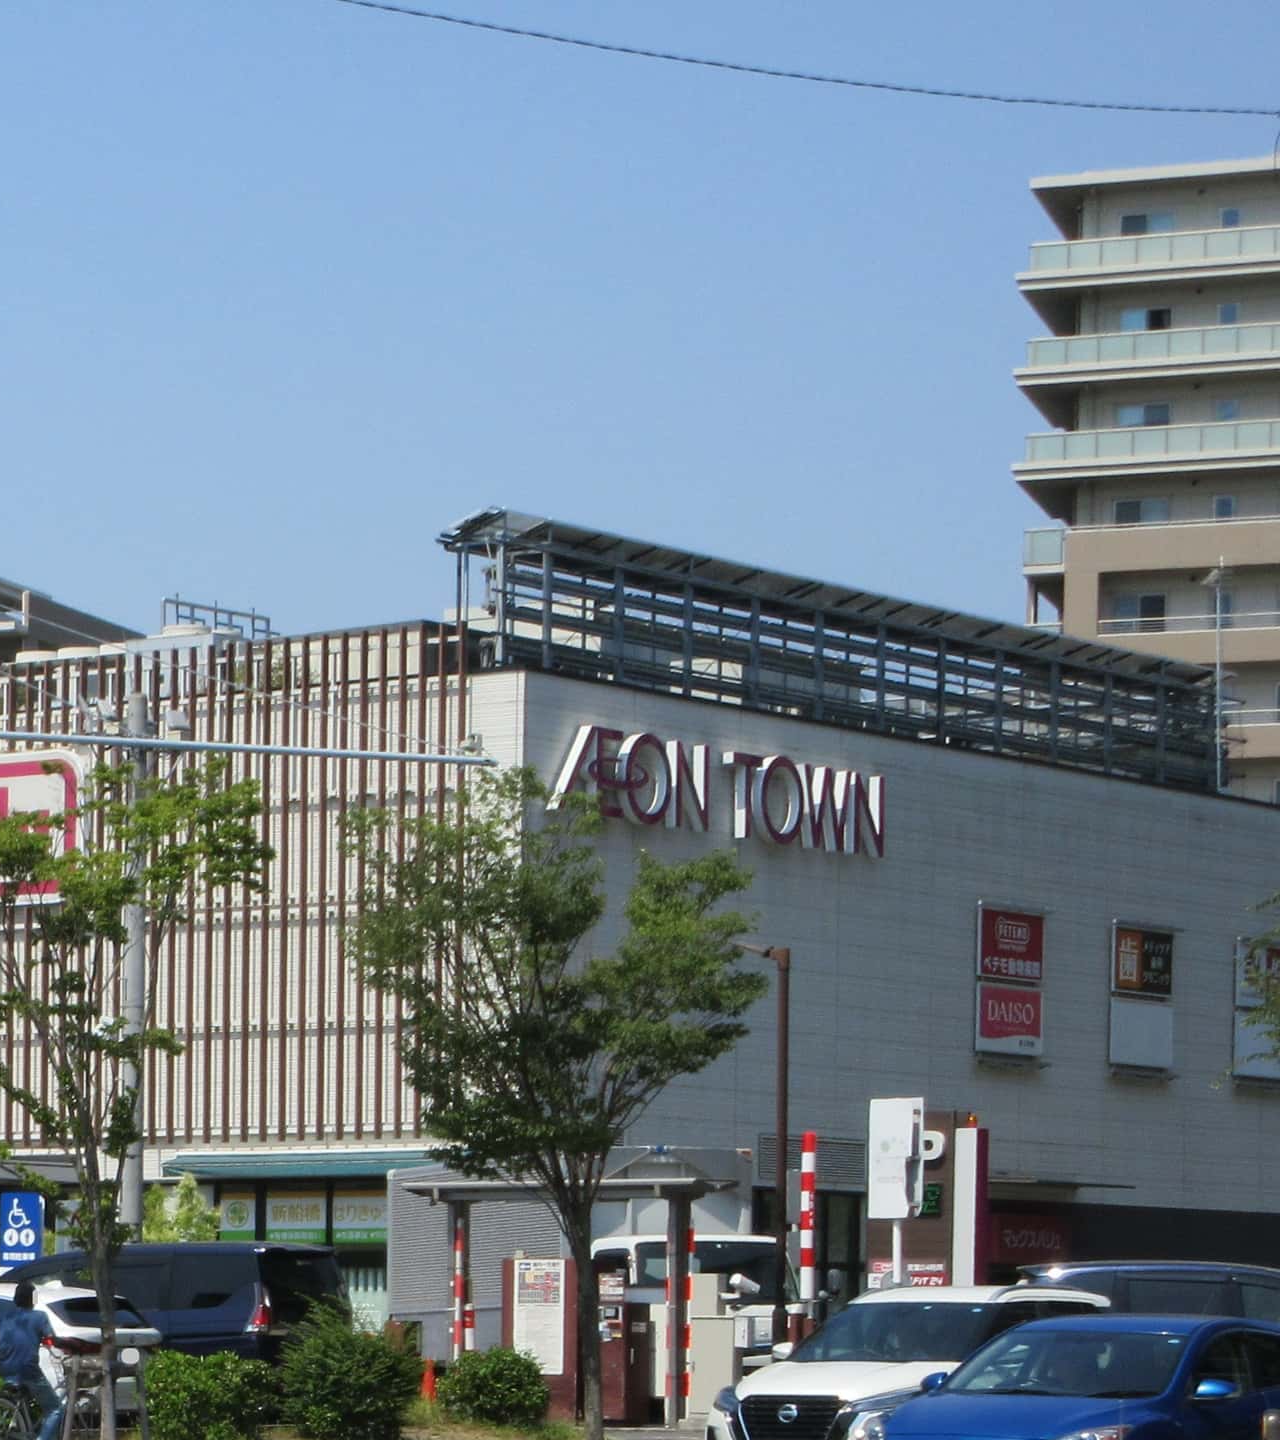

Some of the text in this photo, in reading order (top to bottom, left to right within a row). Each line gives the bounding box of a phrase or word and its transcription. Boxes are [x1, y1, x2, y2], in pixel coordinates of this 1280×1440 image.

[723, 750, 885, 858] TOWN
[987, 1000, 1035, 1025] DAISO
[1002, 1229, 1065, 1249] マックスバリュ
